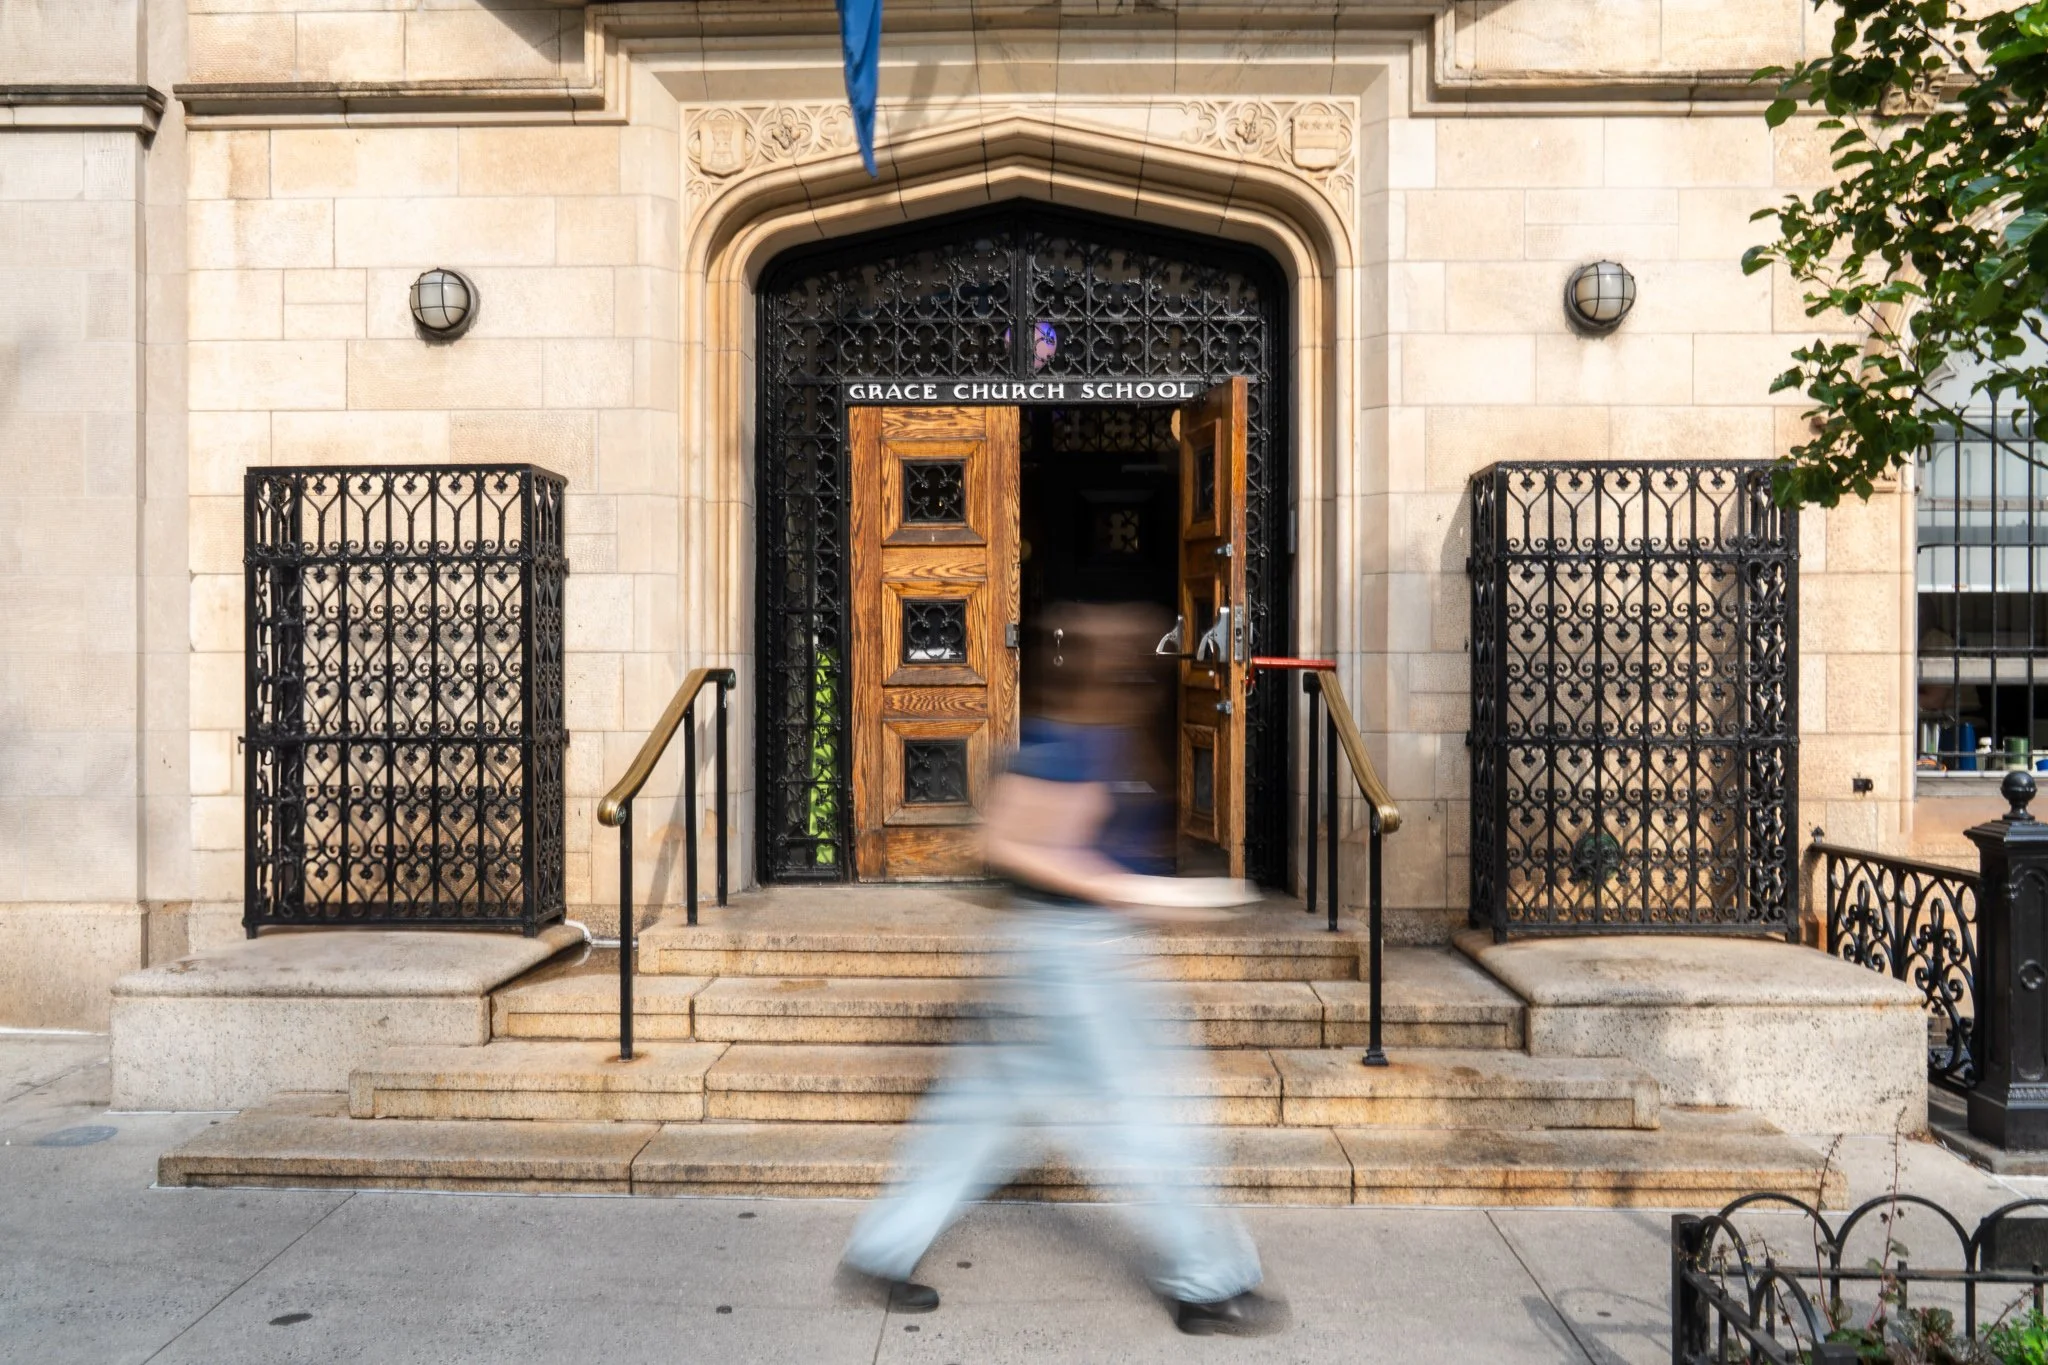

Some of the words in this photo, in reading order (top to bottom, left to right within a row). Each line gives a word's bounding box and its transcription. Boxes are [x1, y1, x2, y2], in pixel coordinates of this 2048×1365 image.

[849, 383, 938, 400] GRACE
[953, 383, 1066, 399] CHURCH
[1080, 382, 1195, 399] SCHOOL
